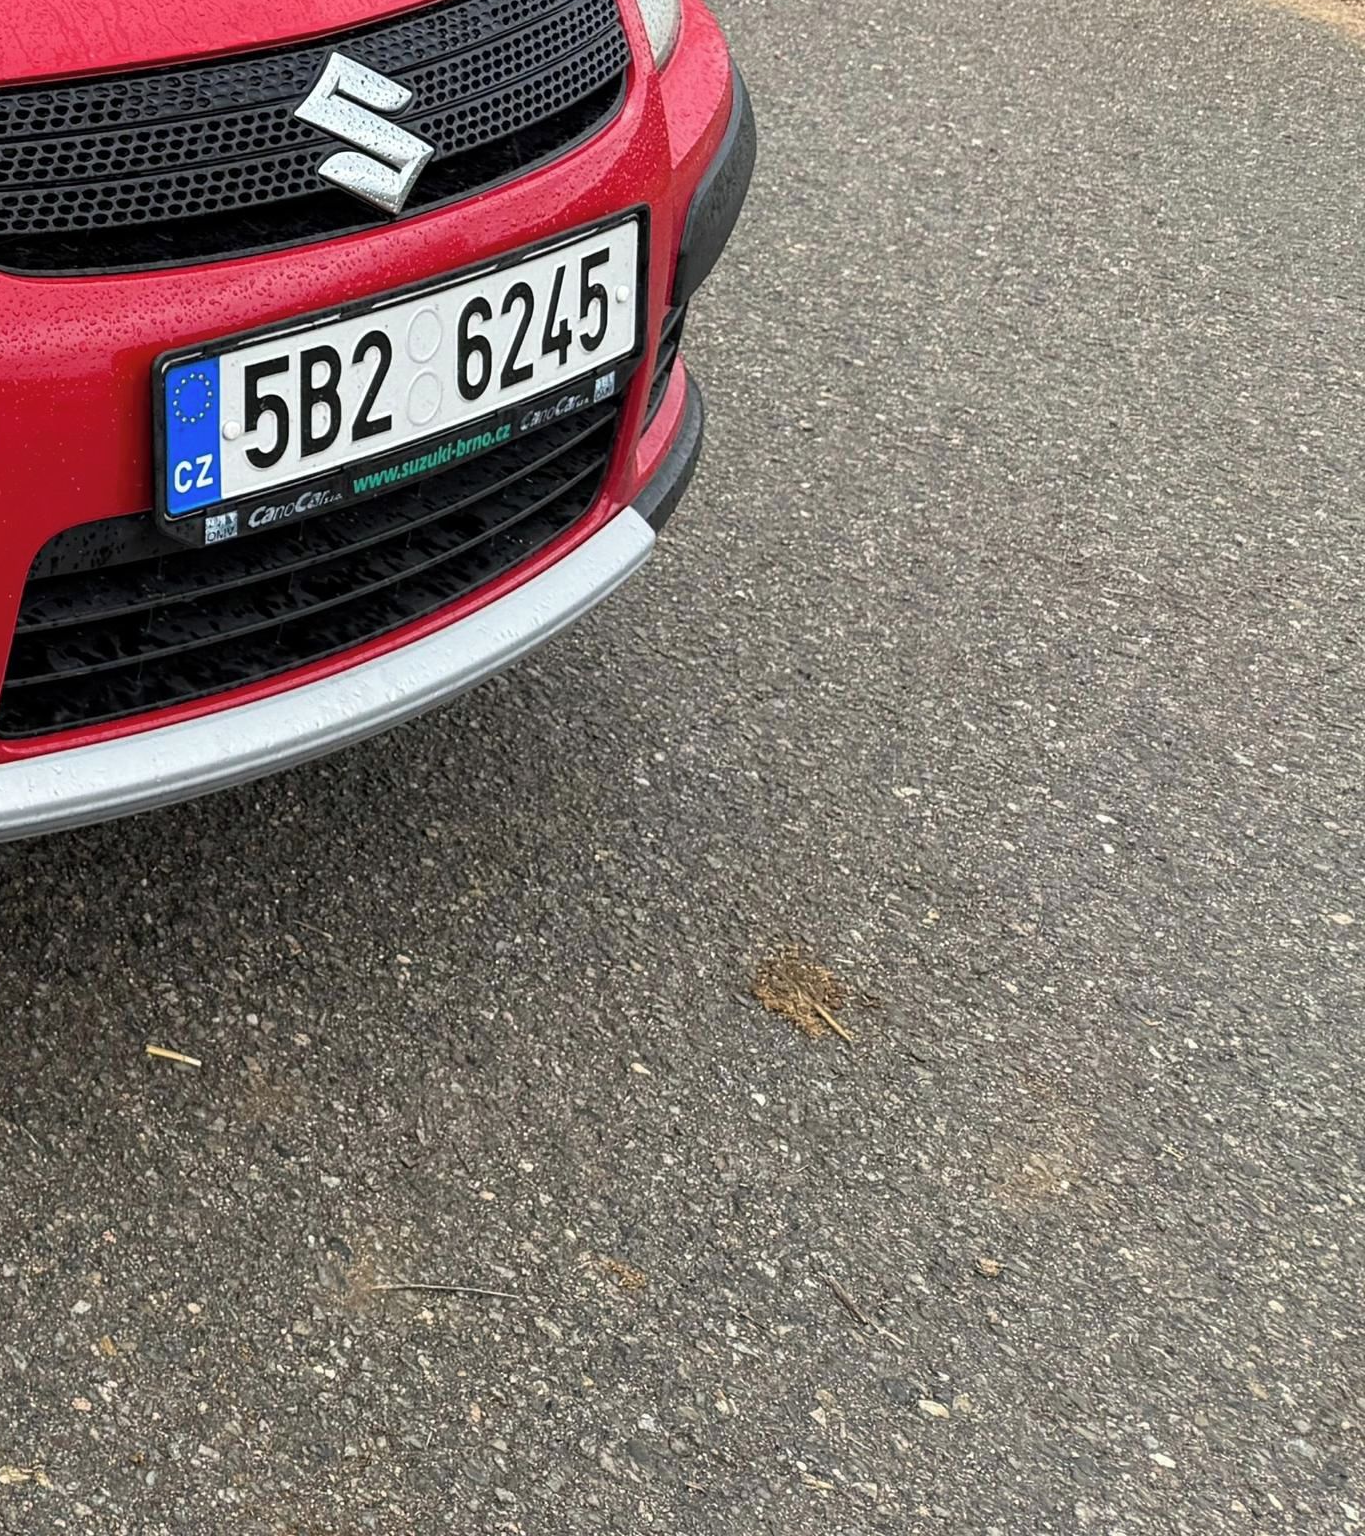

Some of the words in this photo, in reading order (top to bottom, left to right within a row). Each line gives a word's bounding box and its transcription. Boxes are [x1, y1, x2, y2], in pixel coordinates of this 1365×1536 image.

[243, 331, 393, 469] 5B2
[456, 248, 611, 401] 6245
[174, 454, 214, 494] CZ
[353, 424, 512, 494] www.suzuki-brno.cz
[248, 490, 330, 529] CanoCar
